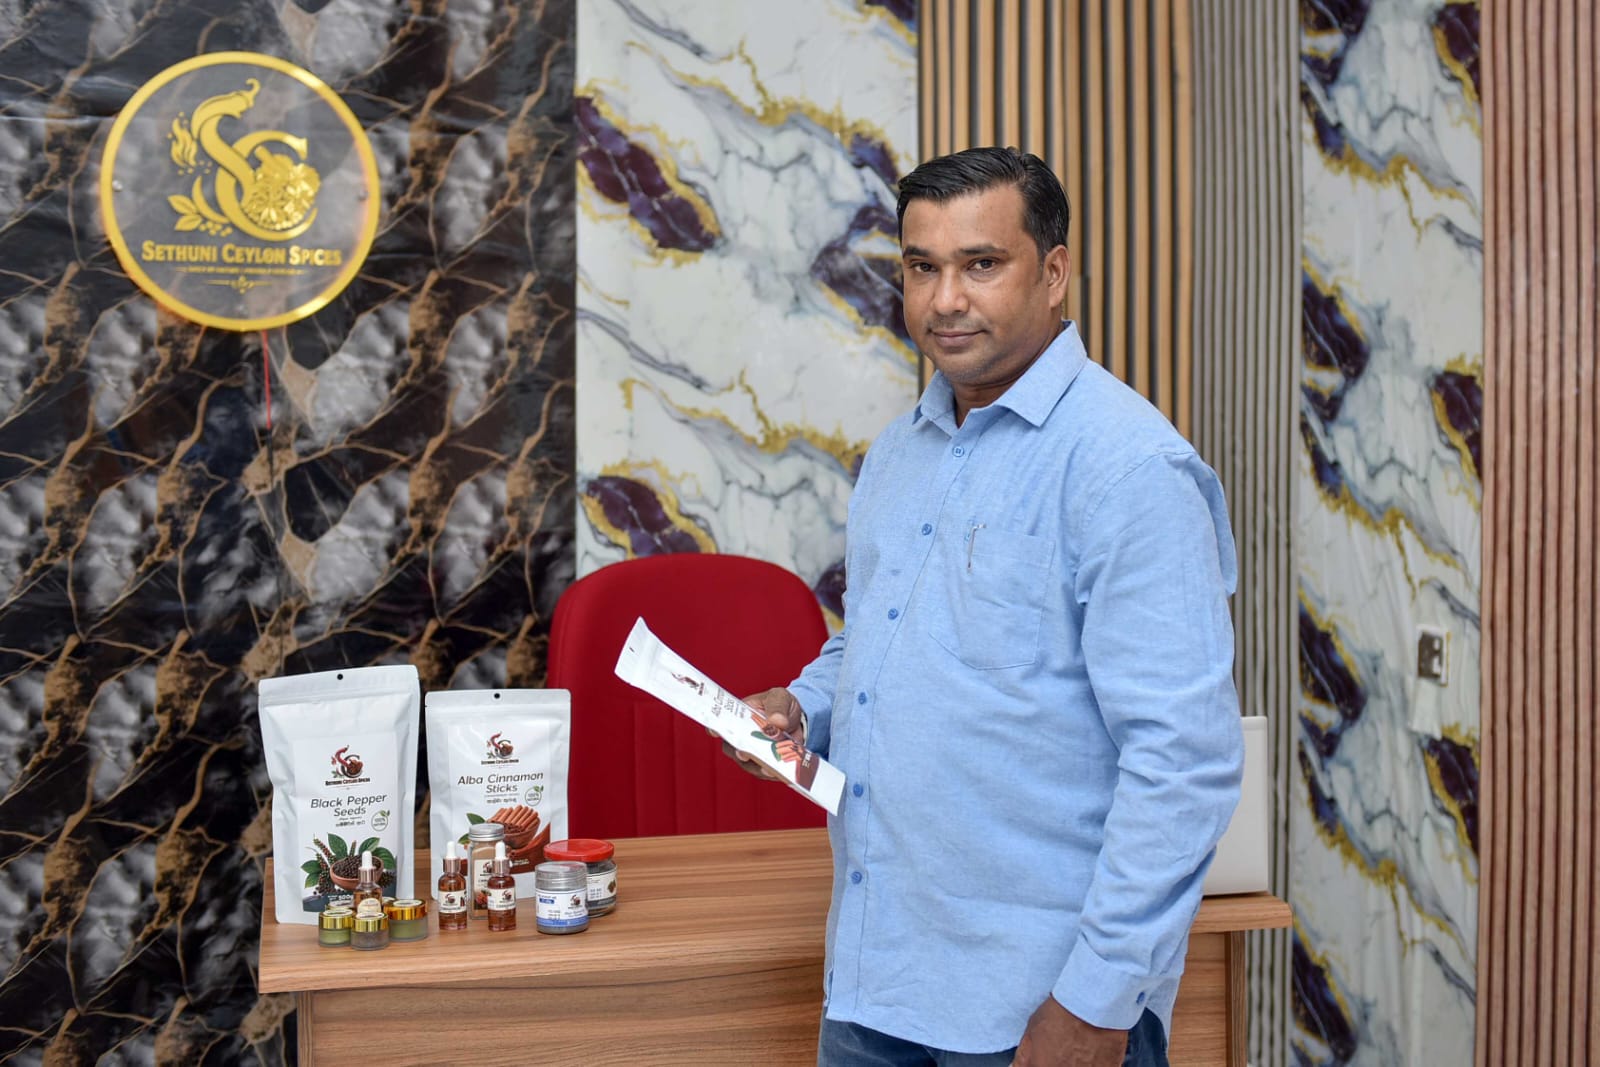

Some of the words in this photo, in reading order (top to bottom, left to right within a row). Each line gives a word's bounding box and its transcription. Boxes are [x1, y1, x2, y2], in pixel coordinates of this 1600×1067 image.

[221, 242, 286, 264] CEYLON
[288, 244, 342, 267] SPICES
[457, 775, 484, 786] Alba
[487, 772, 544, 784] Cinnamon
[485, 784, 518, 794] Sticks
[310, 797, 343, 809] Black
[346, 794, 388, 807] Pepper
[333, 806, 367, 817] Seeds
